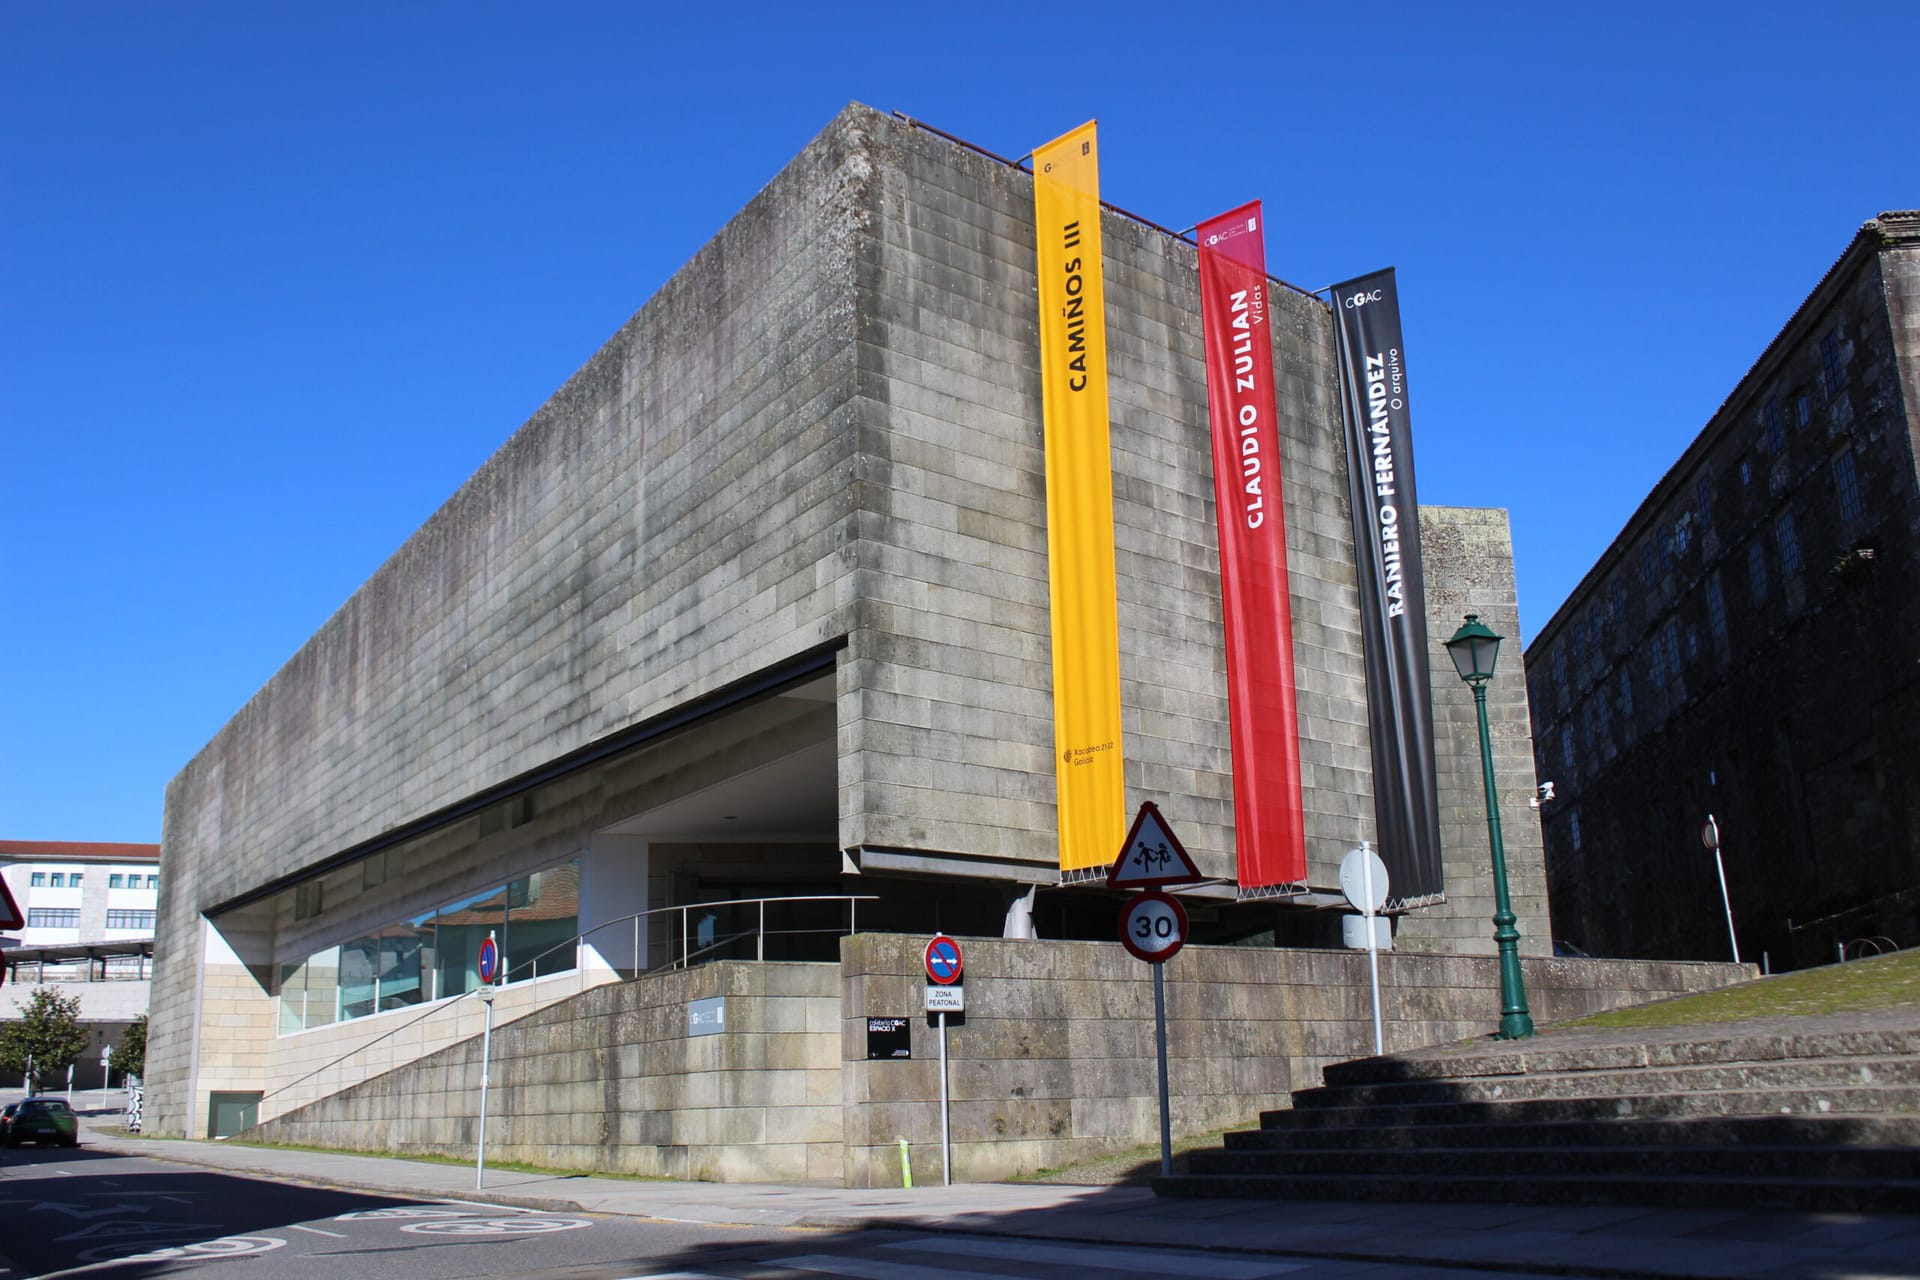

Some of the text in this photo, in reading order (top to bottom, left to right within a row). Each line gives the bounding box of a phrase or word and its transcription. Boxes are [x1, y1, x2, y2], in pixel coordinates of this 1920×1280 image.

[1204, 231, 1228, 247] CGAC
[1063, 221, 1087, 392] CAMIÑOS III
[1251, 285, 1264, 325] Vidas
[1345, 289, 1382, 309] CGAC
[1388, 348, 1402, 410] O arquivo
[1230, 290, 1264, 529] CLAUDIO ZULIAN
[1366, 352, 1404, 618] RANIERO FERNÁNDEZ
[1135, 915, 1172, 938] 30
